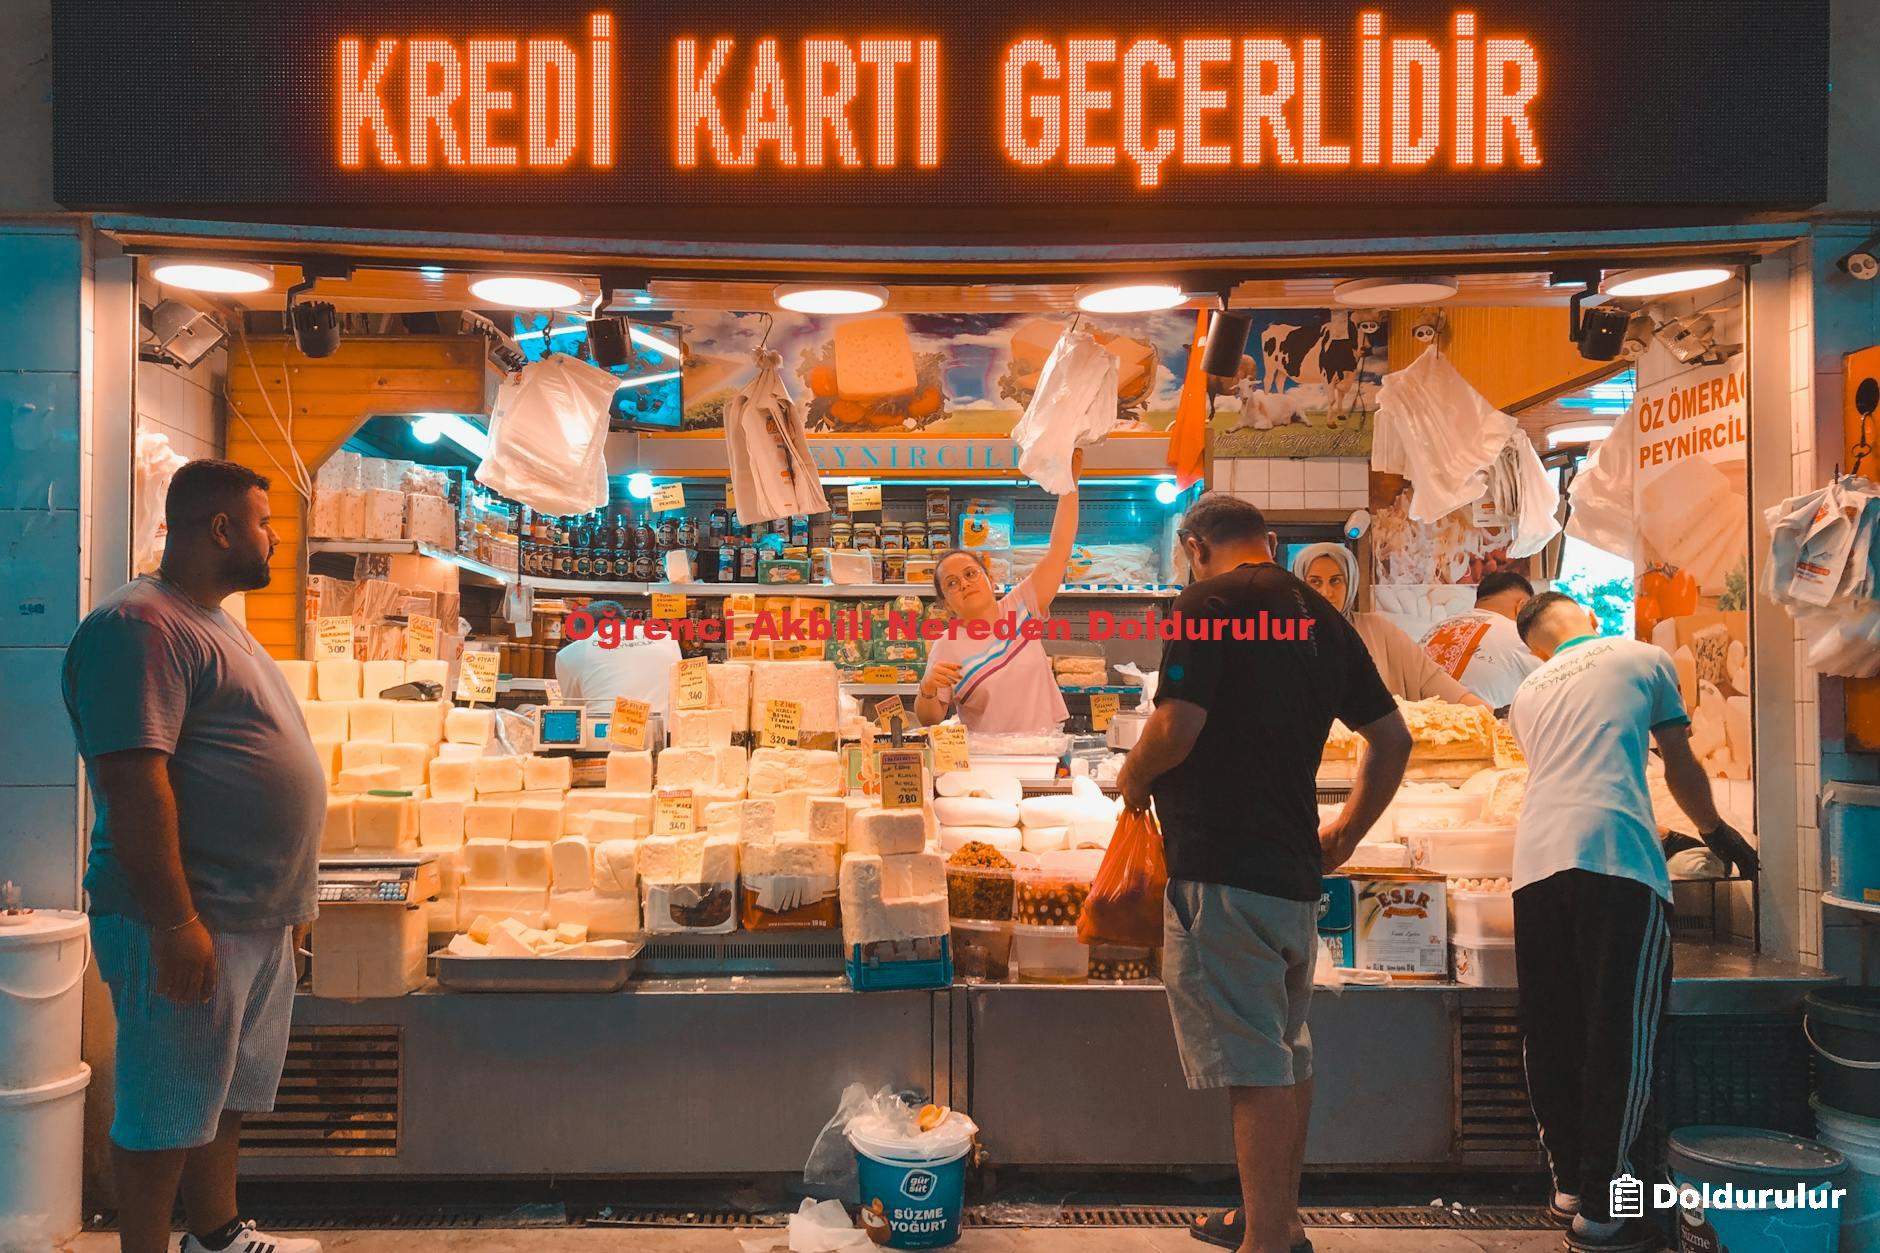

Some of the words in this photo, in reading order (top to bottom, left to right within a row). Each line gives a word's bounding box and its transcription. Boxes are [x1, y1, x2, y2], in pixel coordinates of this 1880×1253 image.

[339, 14, 613, 165] KREDİ
[677, 39, 937, 165] KARTI
[1004, 13, 1542, 187] GEÇERLİDİR
[1640, 396, 1665, 433] ÖZ
[770, 734, 787, 744] 320
[898, 794, 918, 804] 280
[1376, 888, 1431, 909] ESER
[910, 1175, 931, 1185] gür
[908, 1184, 928, 1194] süt
[893, 1207, 944, 1221] SÜZME
[889, 1219, 948, 1234] YOĞURT
